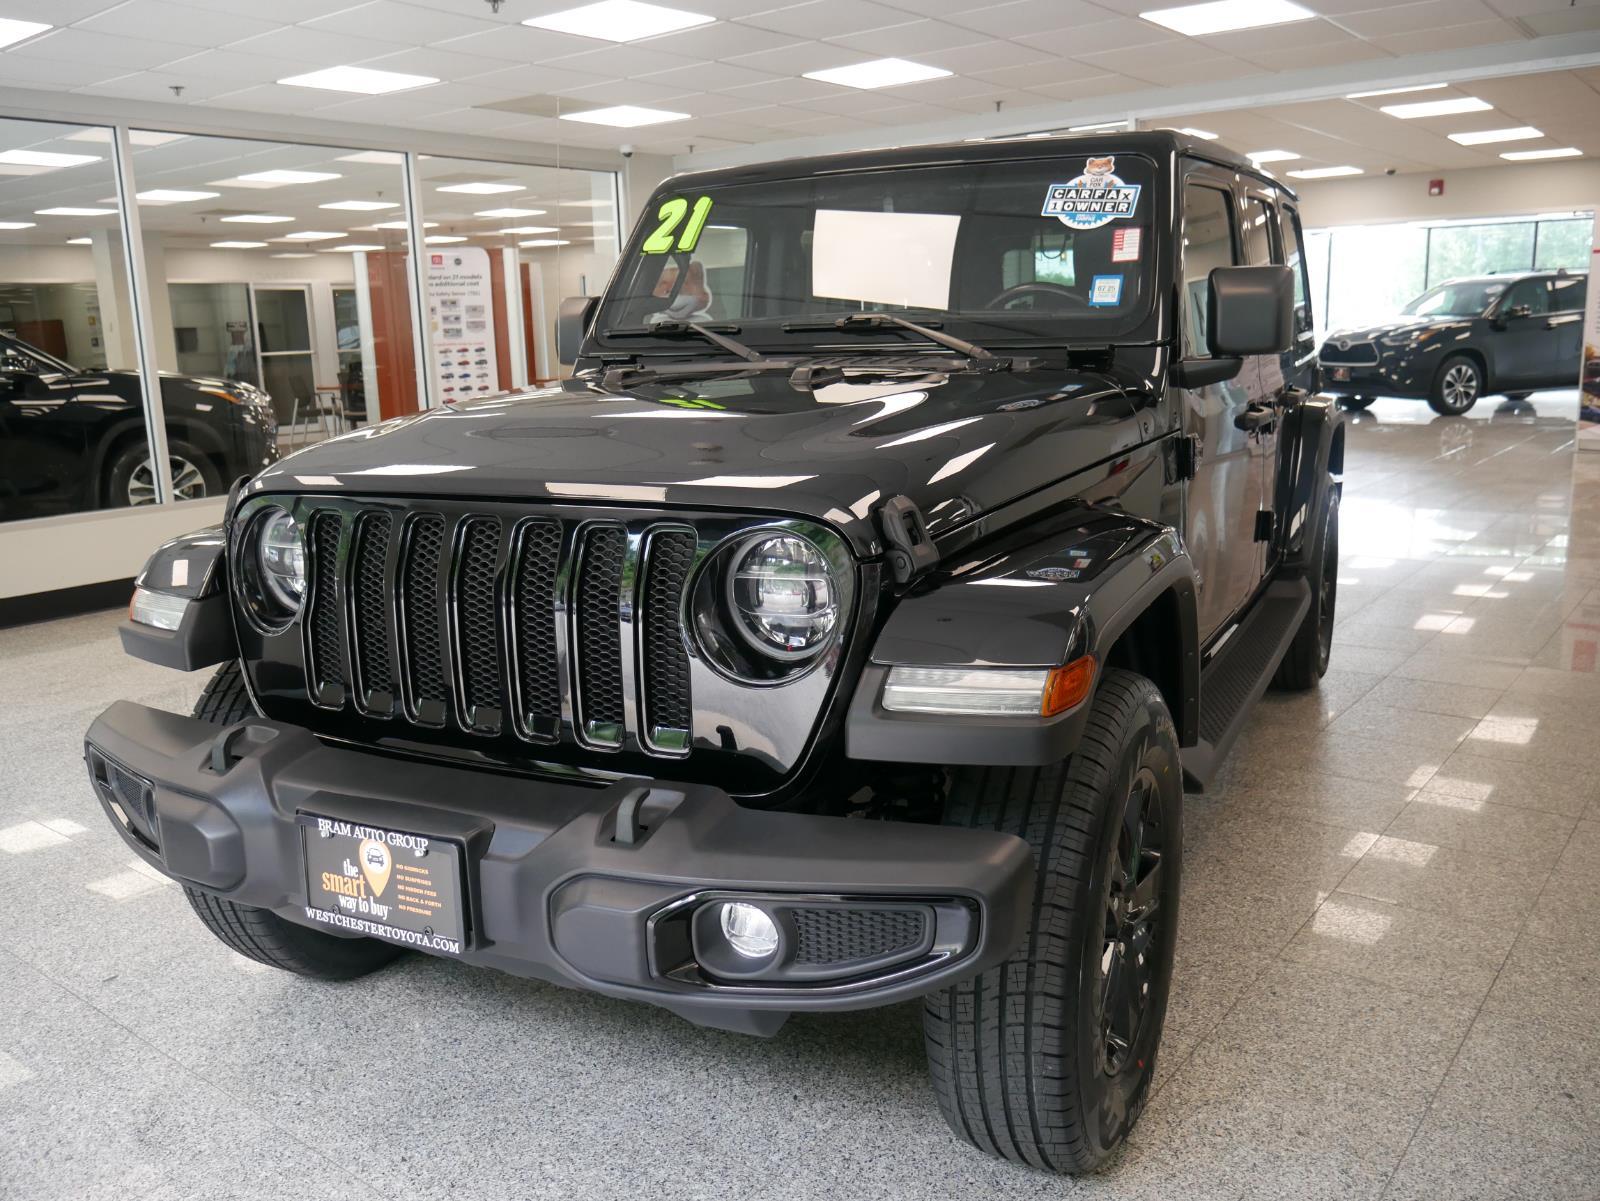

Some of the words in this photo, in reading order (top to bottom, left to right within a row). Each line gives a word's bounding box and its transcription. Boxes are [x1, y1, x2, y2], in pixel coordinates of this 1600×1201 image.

[1051, 202, 1058, 210] 1
[1063, 202, 1130, 212] OWNER
[1054, 189, 1131, 200] CARFAX
[642, 196, 713, 254] 21
[317, 818, 352, 837] BRAM
[353, 826, 386, 843] AUTO
[387, 832, 429, 851] GROUP
[343, 858, 359, 878] the
[322, 871, 367, 899] smart
[338, 894, 357, 912] way
[358, 896, 369, 913] to
[369, 896, 389, 920] buy
[305, 906, 460, 954] WESTCHESTERTOYOTA.COM
